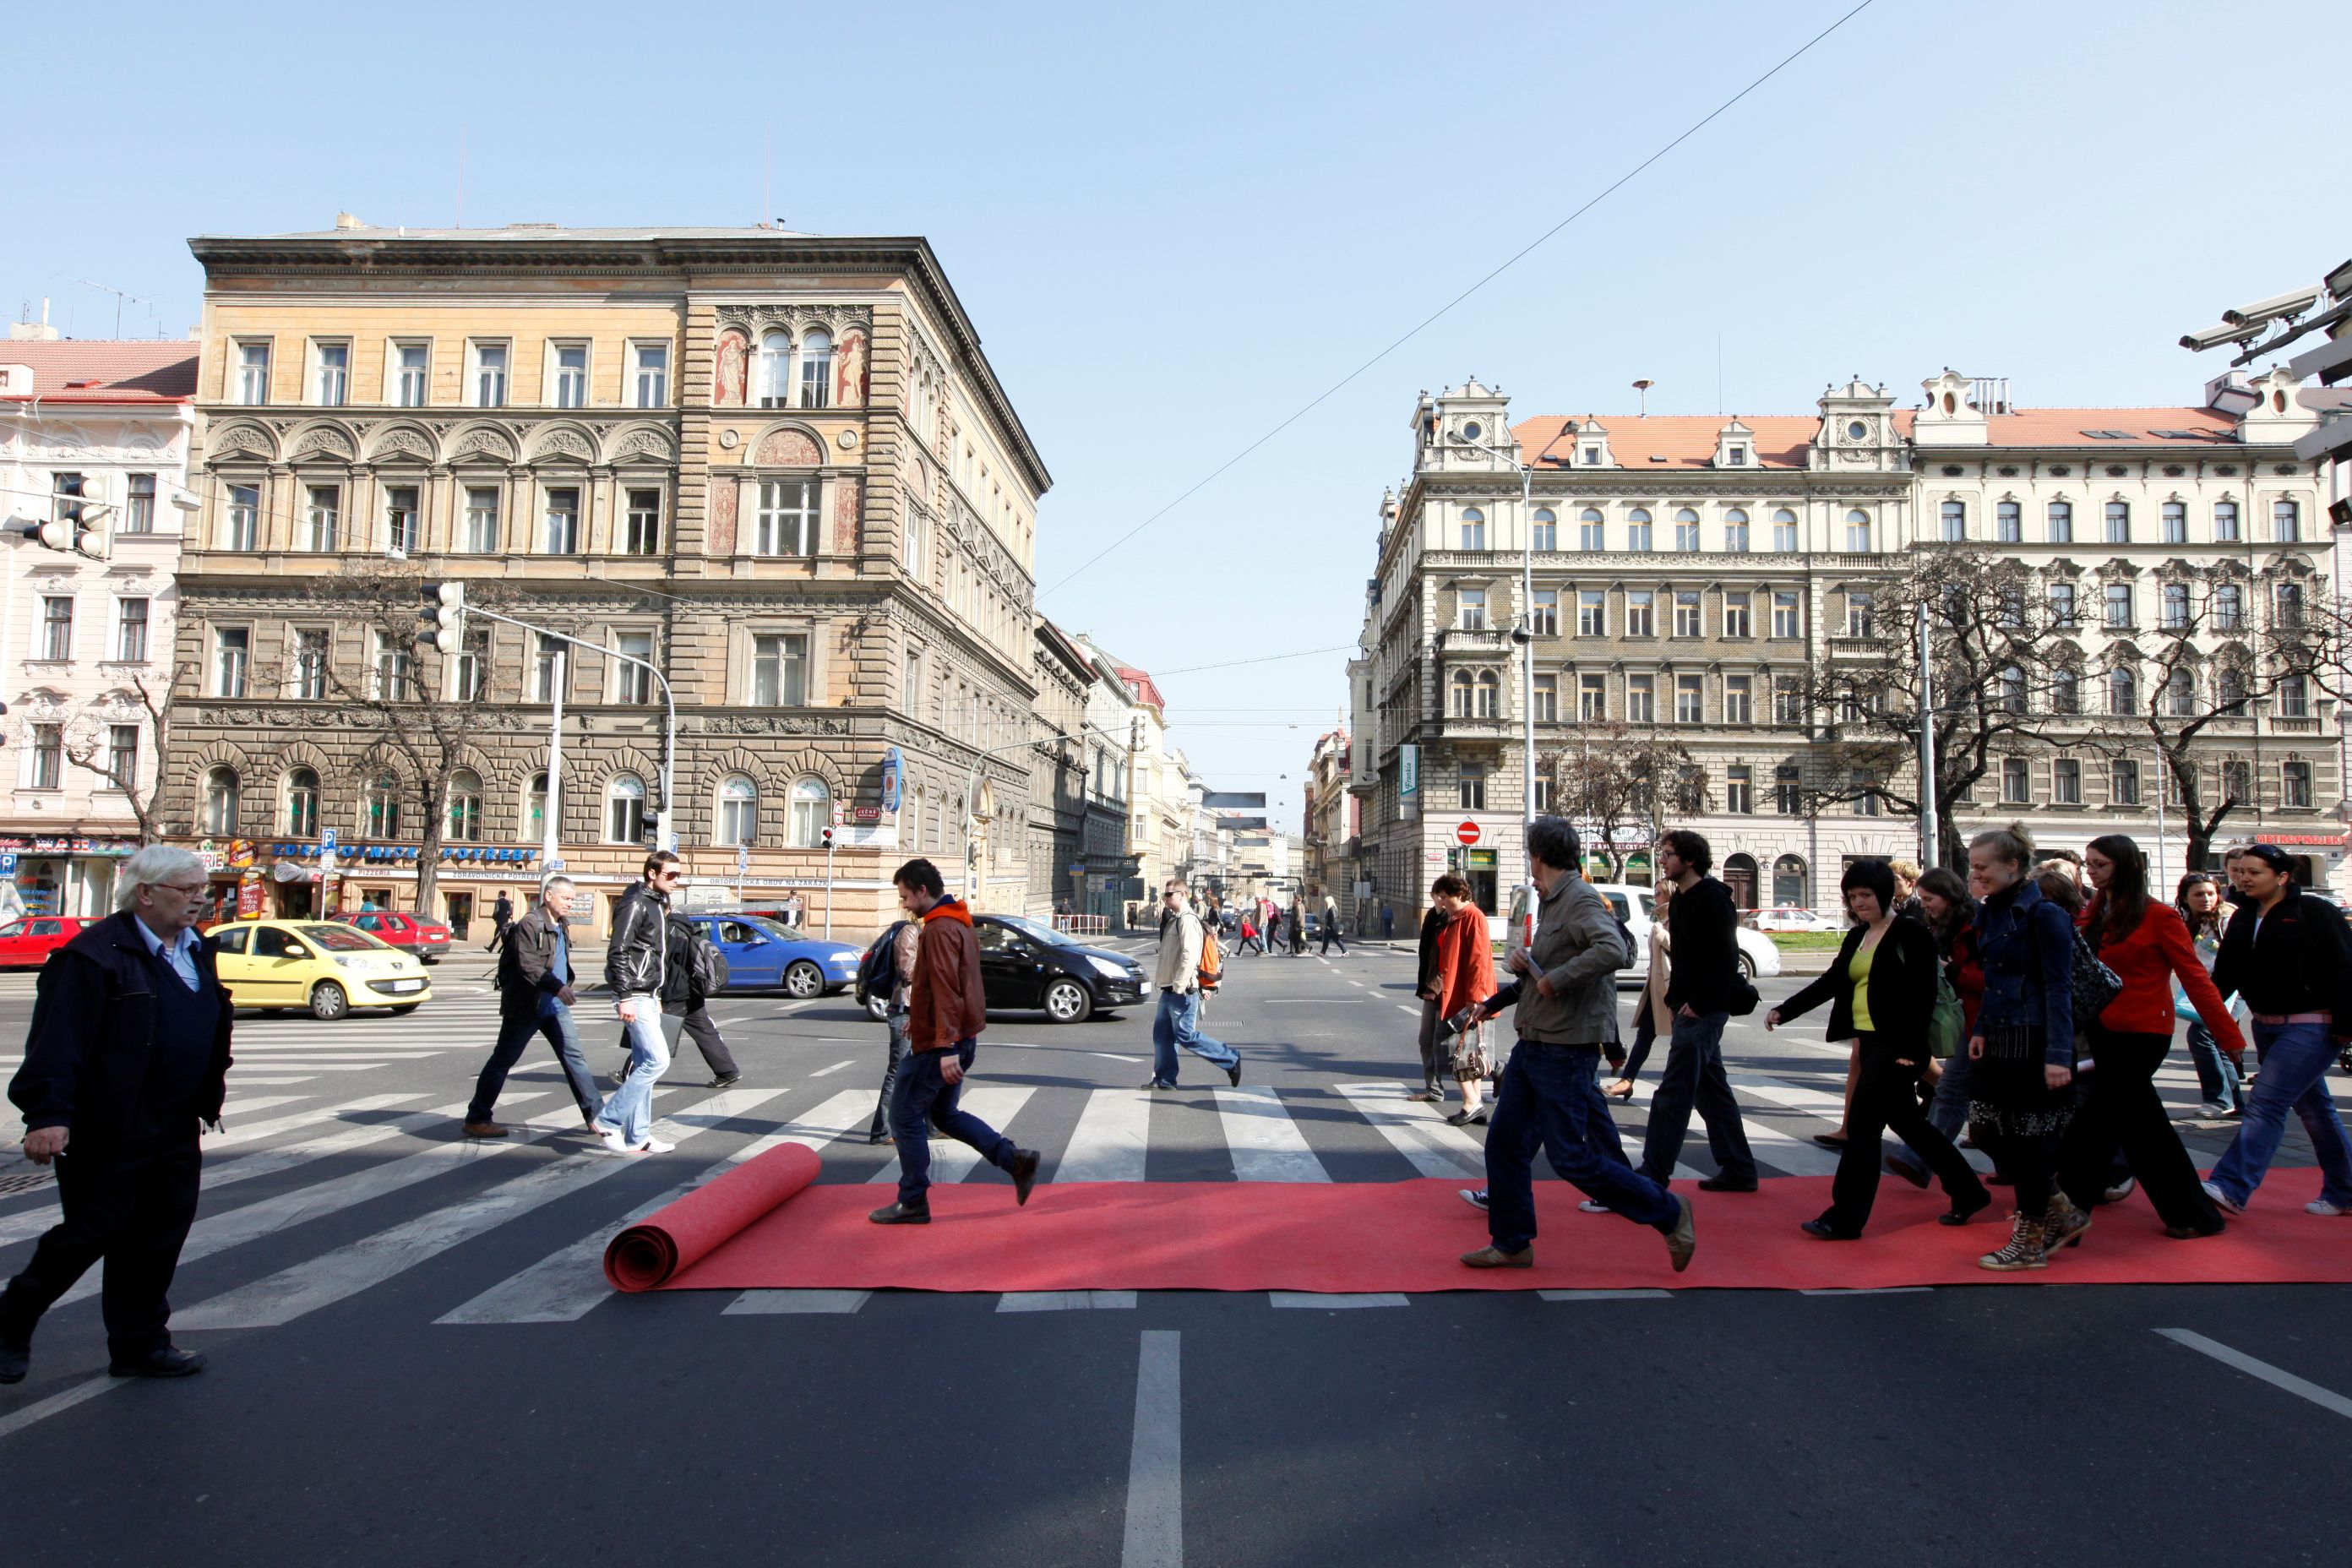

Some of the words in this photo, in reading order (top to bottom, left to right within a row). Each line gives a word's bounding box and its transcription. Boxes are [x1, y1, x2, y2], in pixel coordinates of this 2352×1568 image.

[35, 838, 95, 852] NAIL
[2257, 835, 2347, 845] METROPROJEKT
[272, 843, 420, 859] ZDRAOTNICK
[443, 846, 537, 861] POTŘEBY
[453, 871, 505, 879] ZDRAVOTNICKÉ
[508, 872, 540, 880] POTŘEBY
